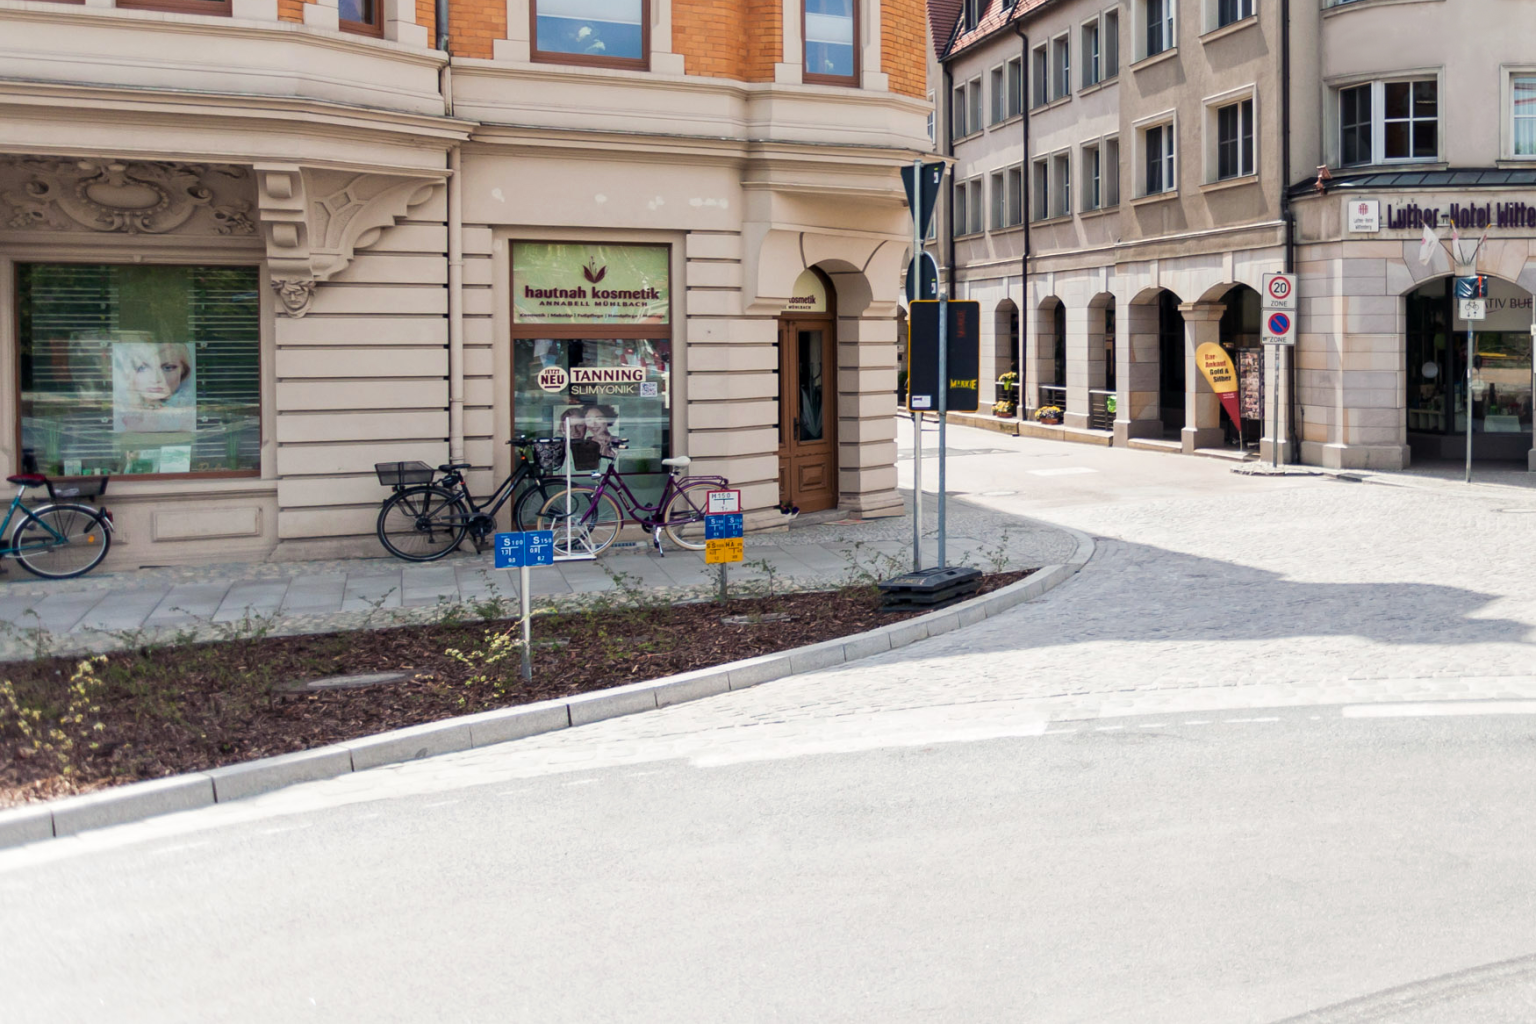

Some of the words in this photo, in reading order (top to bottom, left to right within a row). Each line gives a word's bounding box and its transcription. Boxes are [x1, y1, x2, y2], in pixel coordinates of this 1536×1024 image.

[525, 285, 587, 299] hautnah
[591, 286, 660, 300] kosmetik
[1273, 282, 1287, 293] 20
[541, 375, 564, 384] NEU
[573, 370, 643, 381] TANNING
